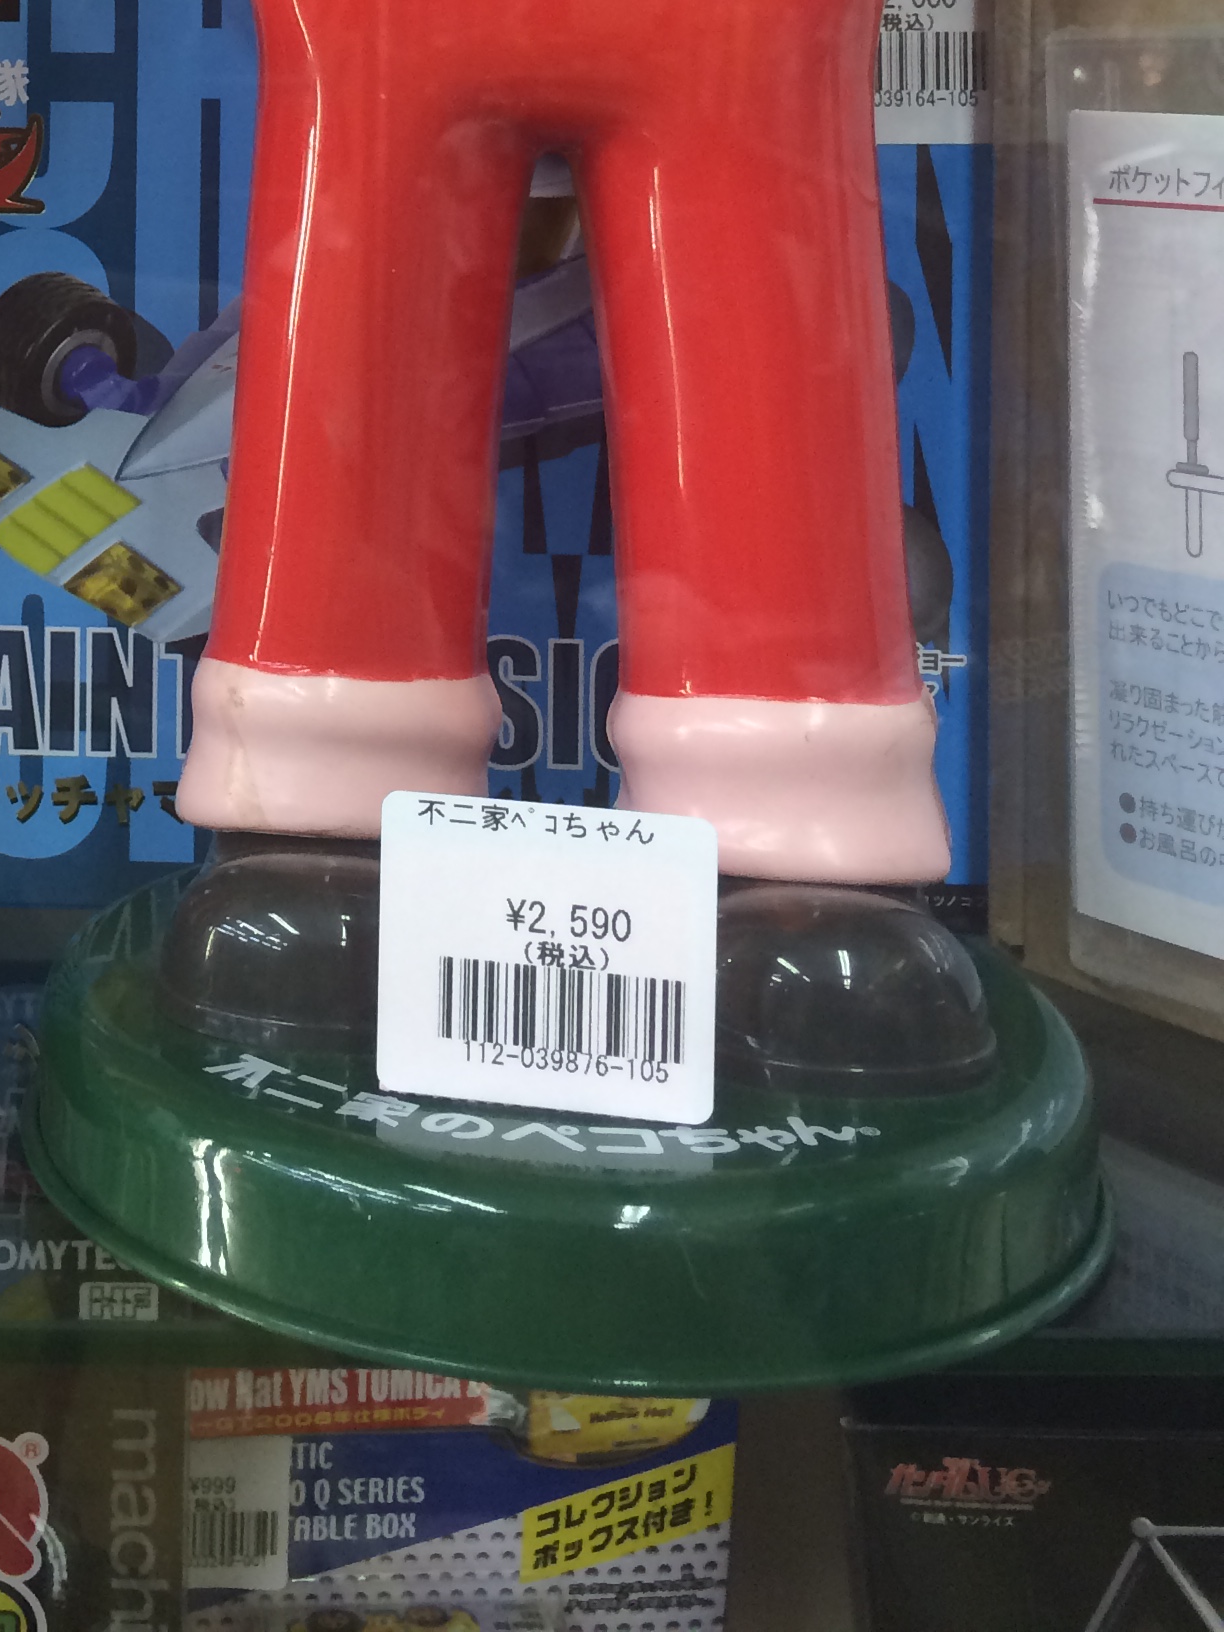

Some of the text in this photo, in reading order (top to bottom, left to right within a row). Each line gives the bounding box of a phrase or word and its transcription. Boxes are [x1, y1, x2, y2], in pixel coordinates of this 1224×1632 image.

[507, 898, 632, 943] ¥2,590
[524, 941, 610, 970] (税込)
[463, 1039, 669, 1083] 112-039876-105
[338, 1476, 426, 1505] SERIES
[536, 1464, 698, 1538] コレクション
[366, 1513, 417, 1540] BOX
